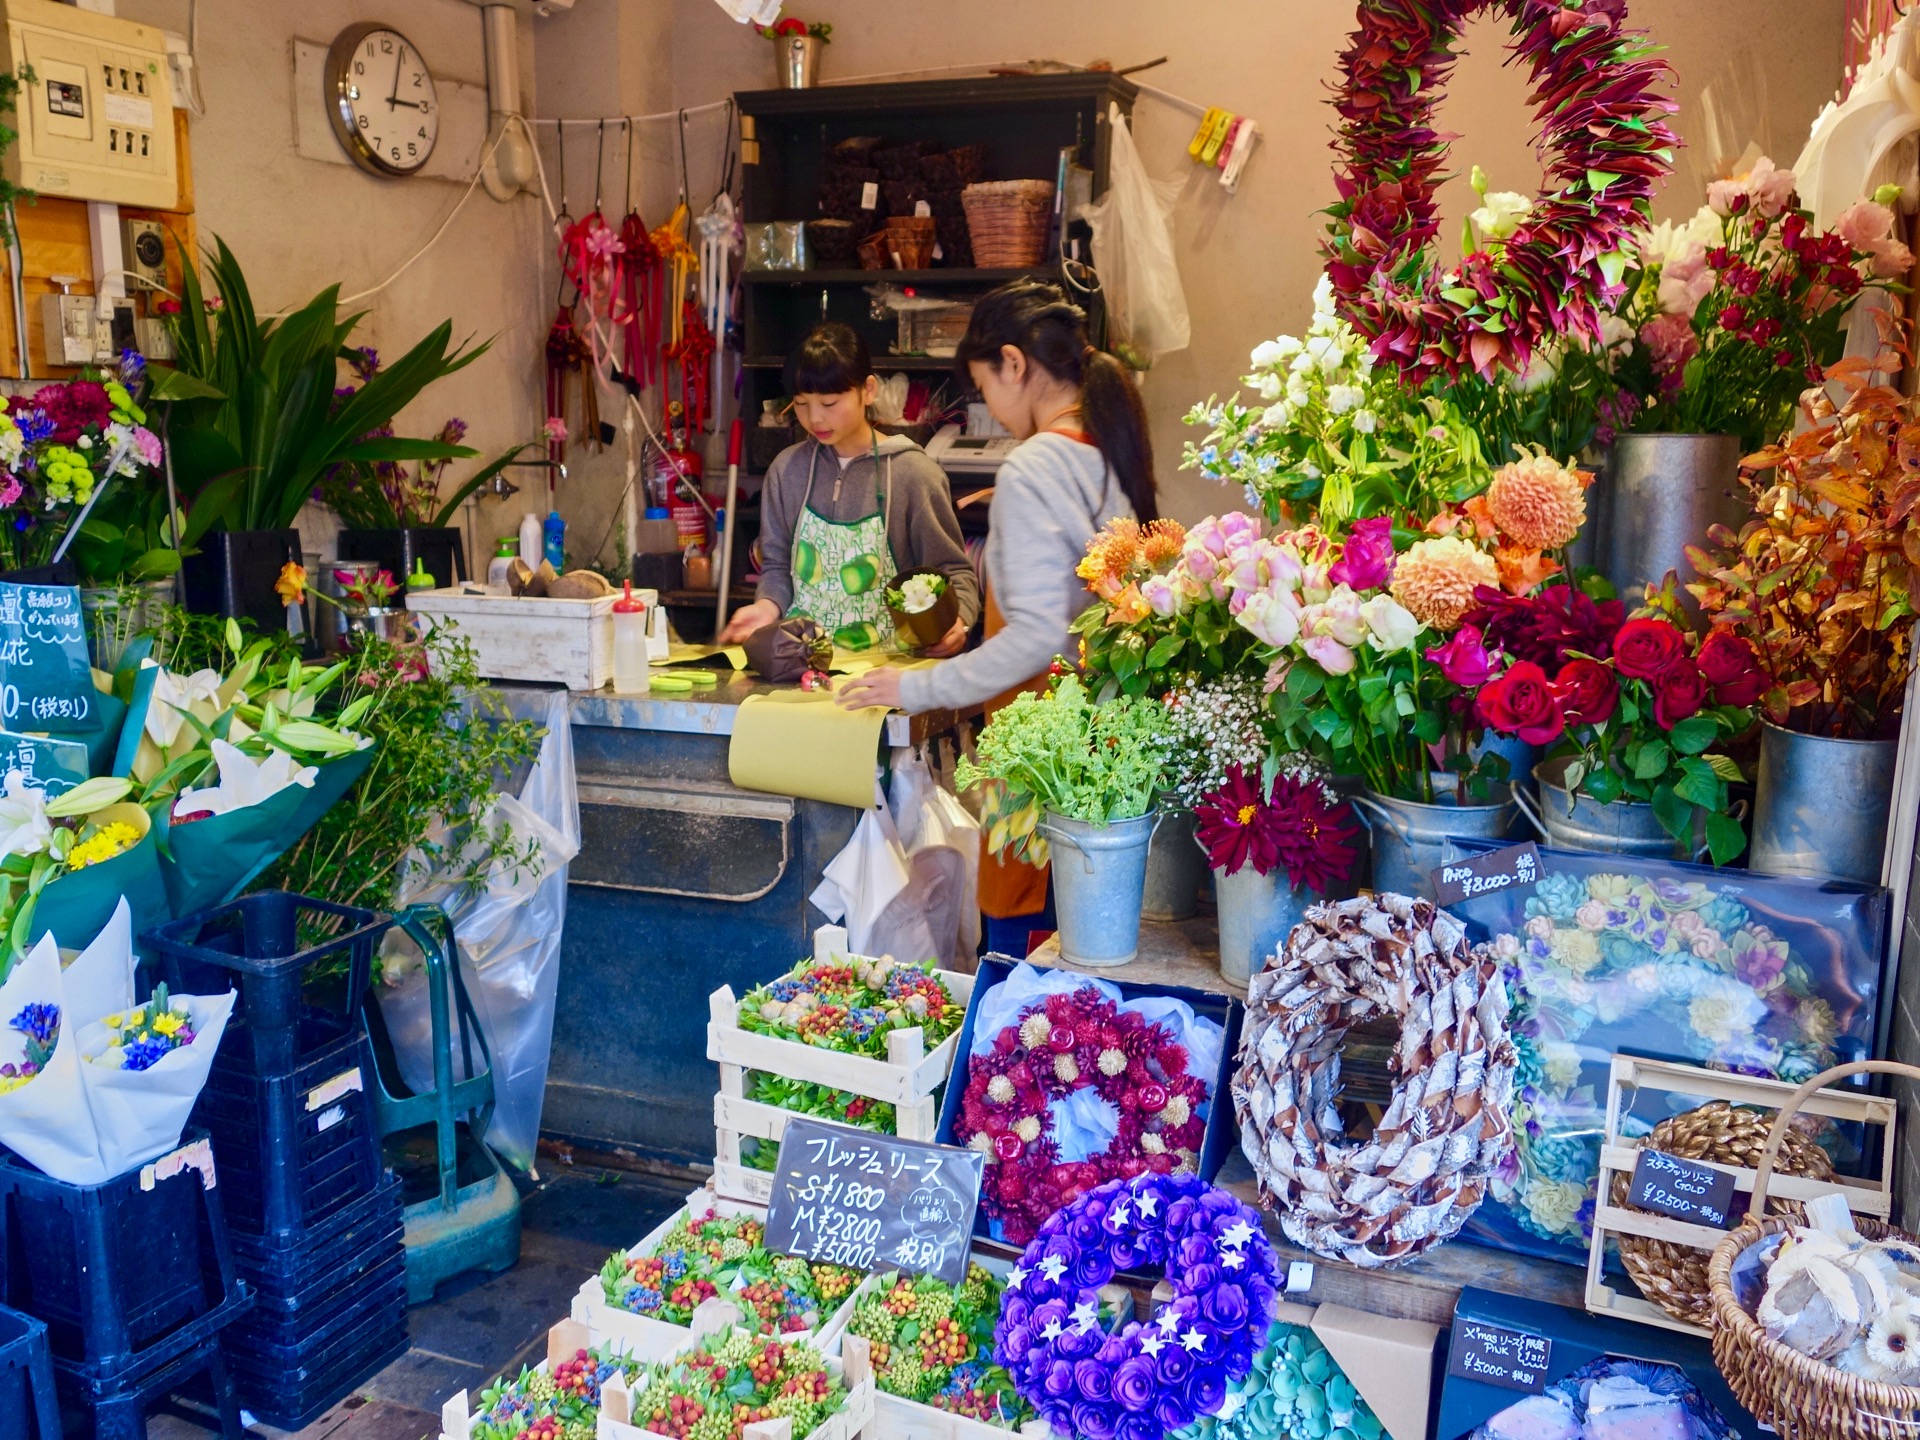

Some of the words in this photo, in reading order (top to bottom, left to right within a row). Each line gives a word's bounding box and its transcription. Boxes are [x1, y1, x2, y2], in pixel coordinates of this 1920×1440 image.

[366, 42, 375, 58] 11
[380, 38, 393, 55] 12
[354, 60, 365, 76] 10
[412, 73, 422, 88] 2
[420, 100, 429, 114] 3
[358, 114, 369, 129] 8
[417, 126, 427, 139] 4
[372, 136, 382, 151] 7
[407, 142, 417, 156] 5
[391, 147, 401, 161] 6
[1674, 1178, 1706, 1195] GOLD
[790, 1205, 815, 1232] M
[789, 1231, 807, 1255] L
[895, 1236, 946, 1271] 税別
